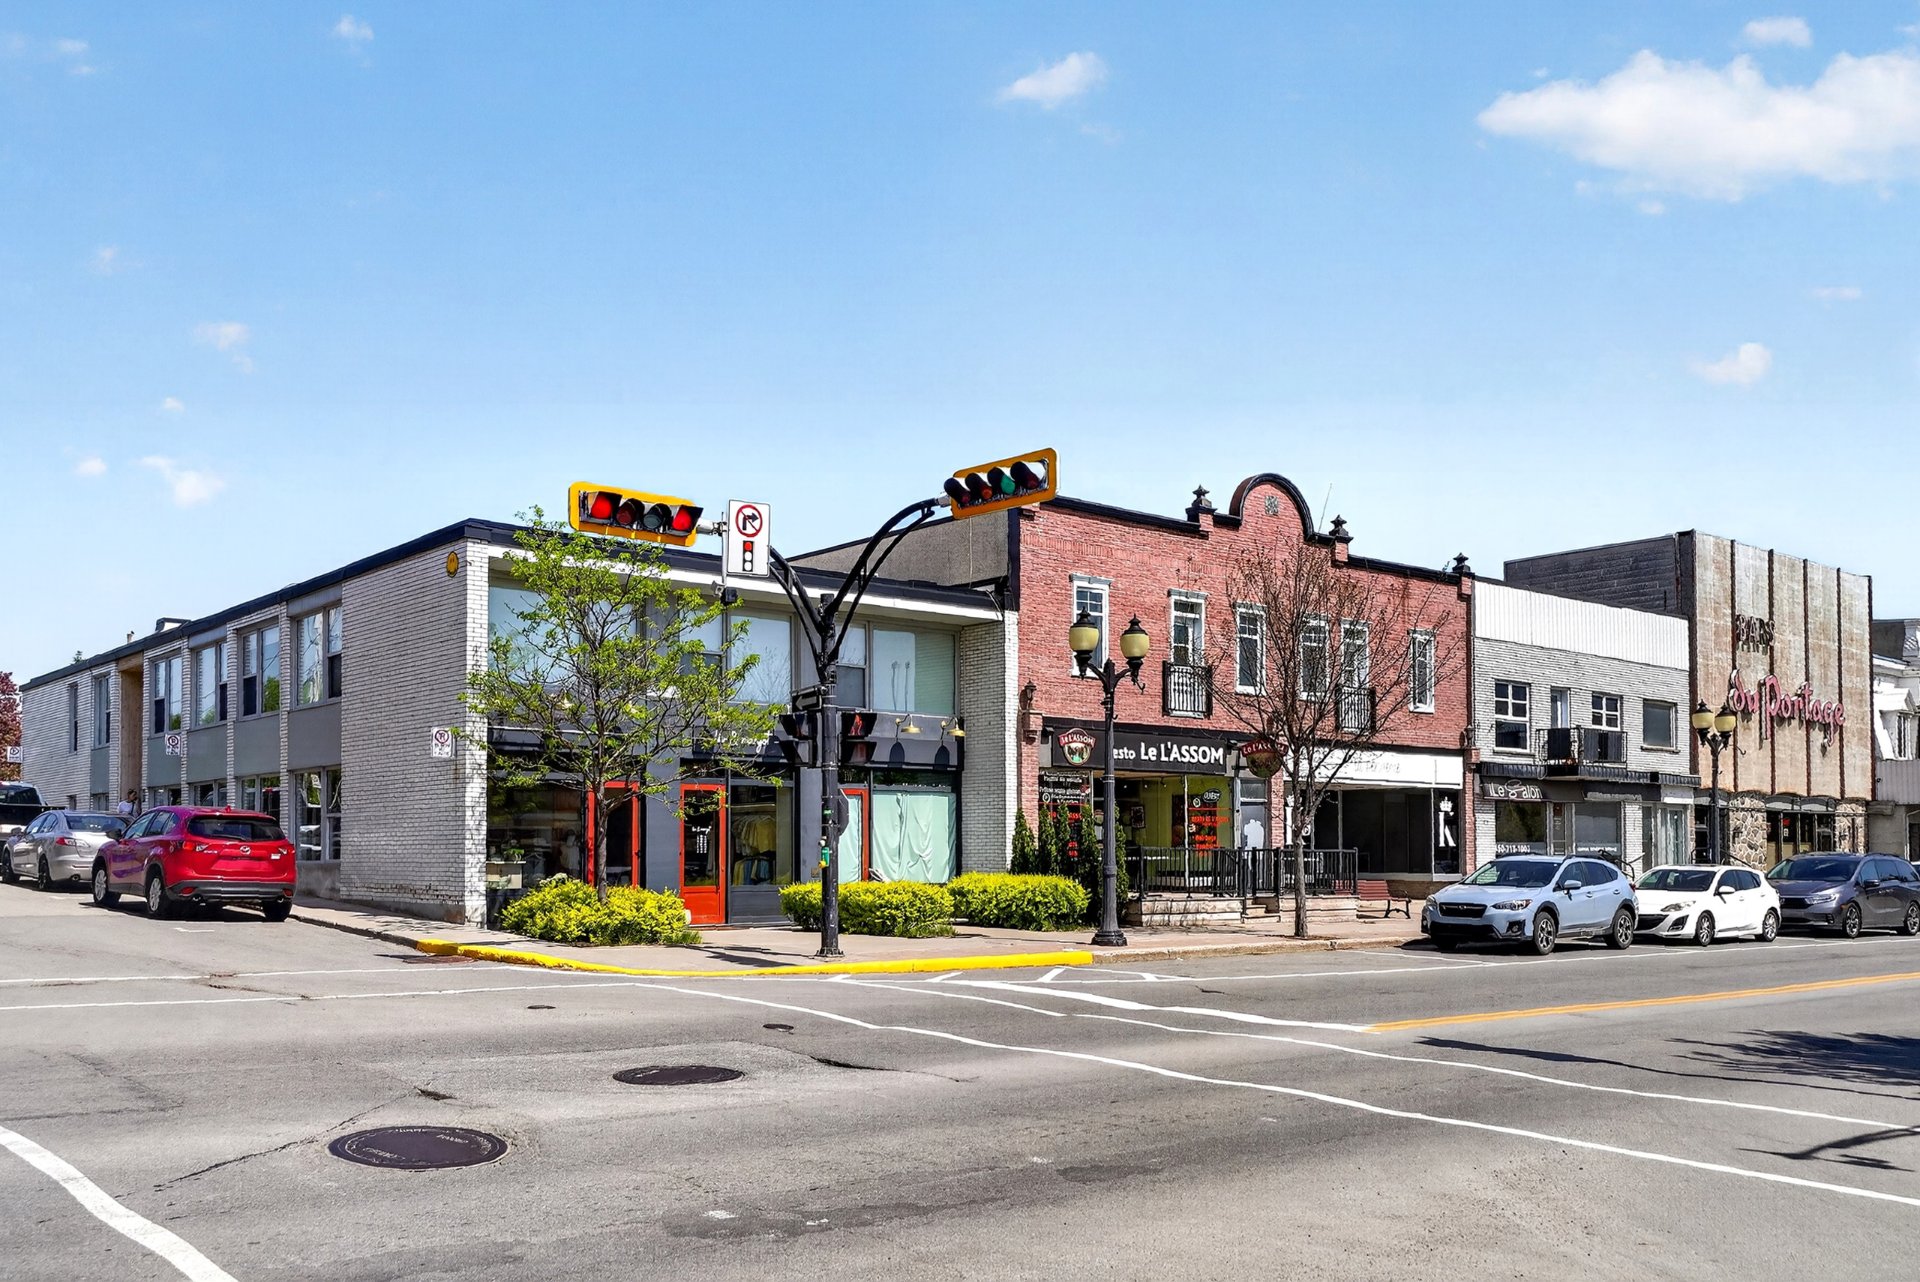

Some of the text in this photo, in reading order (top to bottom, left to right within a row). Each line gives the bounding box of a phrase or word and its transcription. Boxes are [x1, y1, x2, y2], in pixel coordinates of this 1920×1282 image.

[1758, 674, 1846, 747] Portage
[1113, 741, 1224, 765] esto Le L'ASSOM
